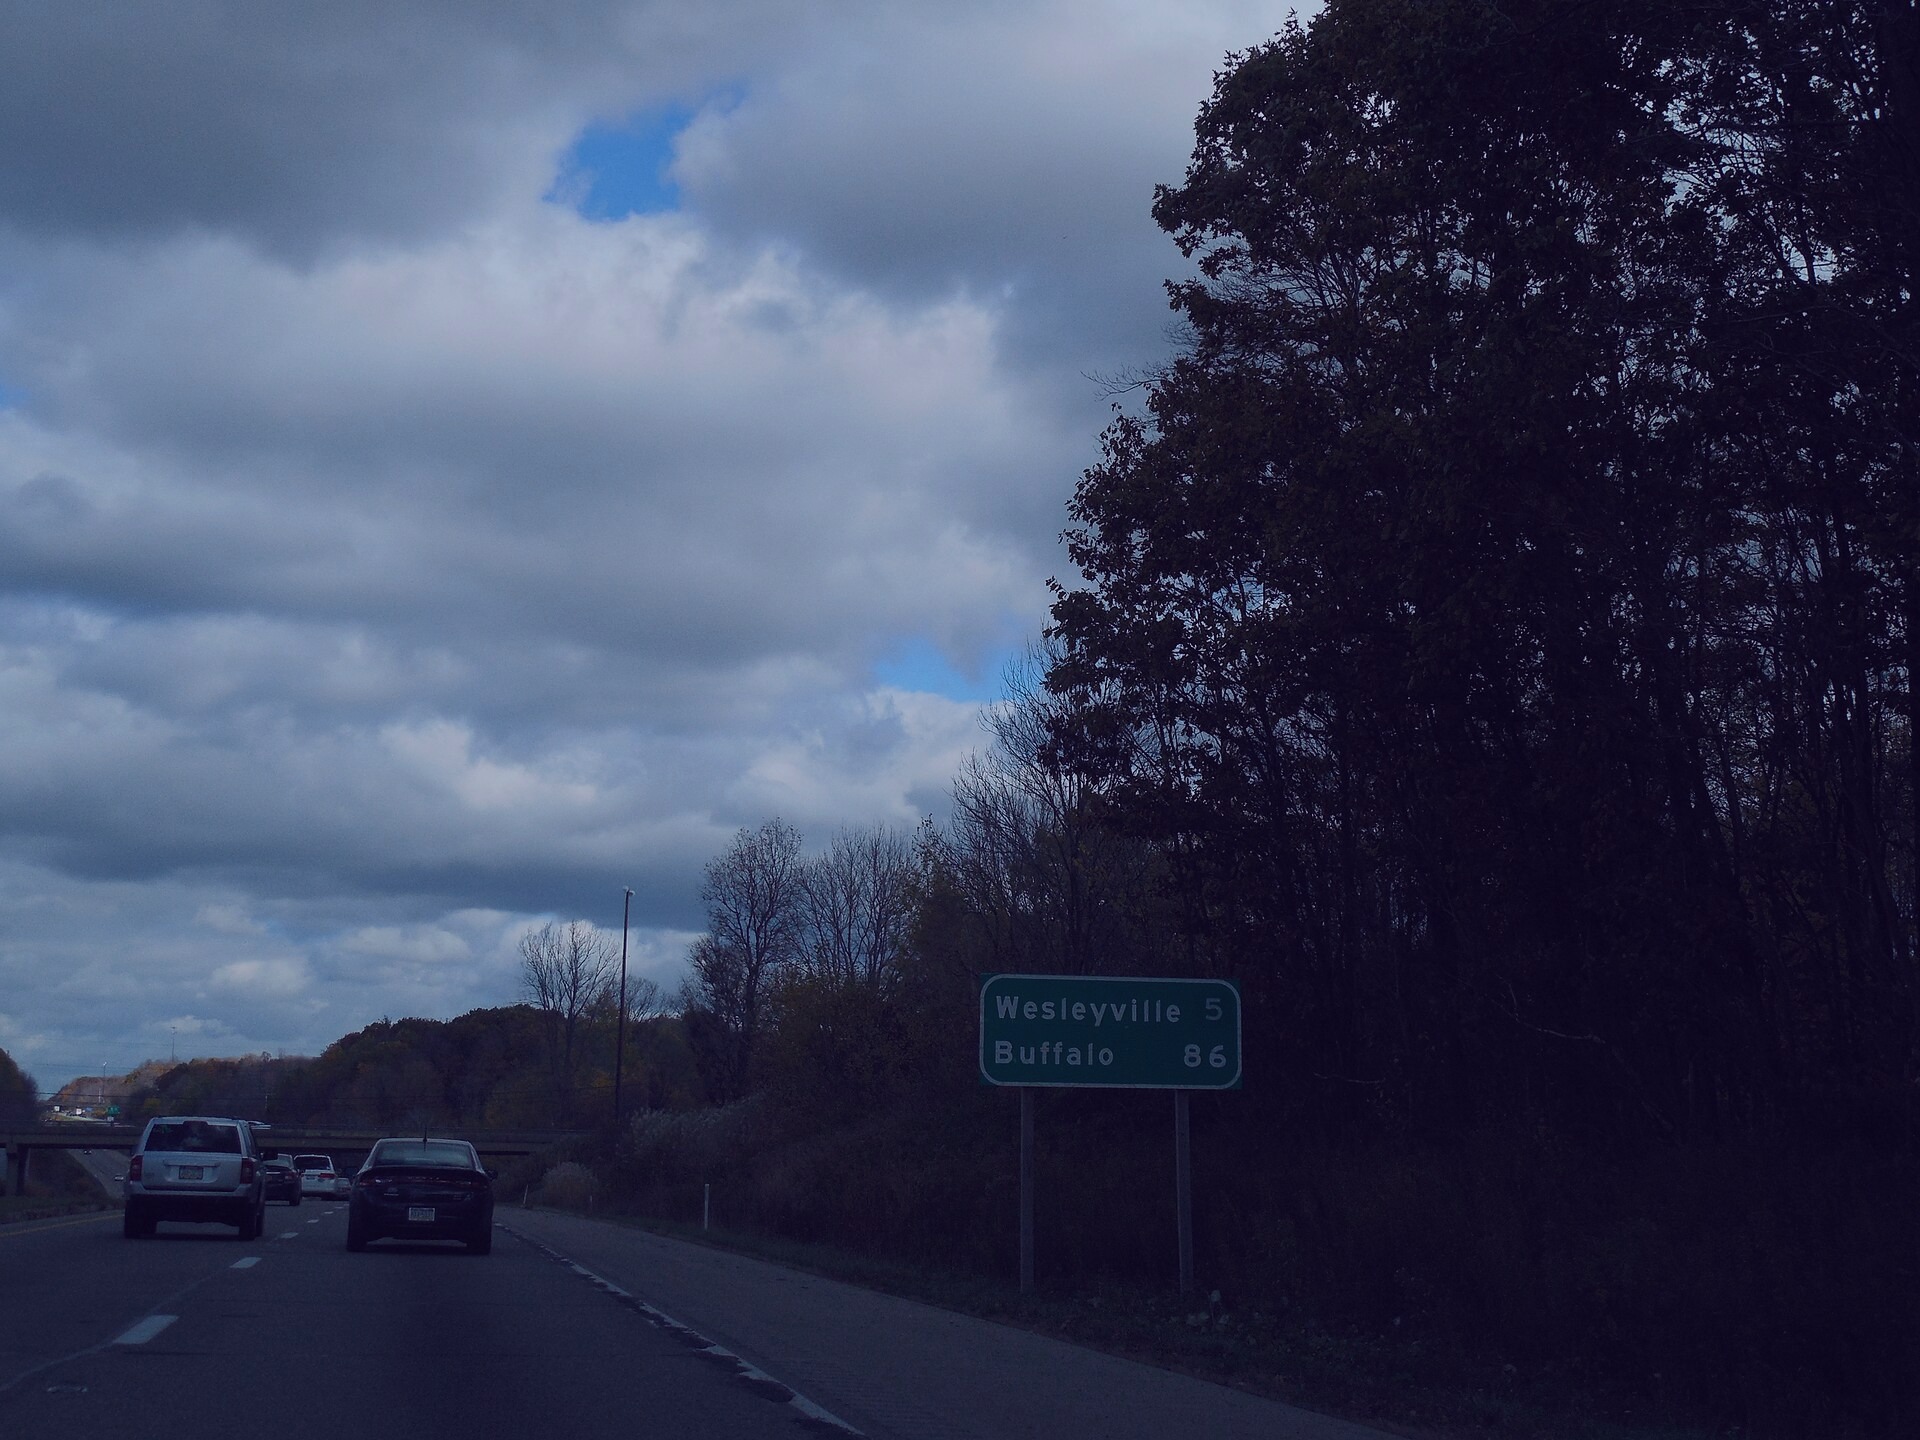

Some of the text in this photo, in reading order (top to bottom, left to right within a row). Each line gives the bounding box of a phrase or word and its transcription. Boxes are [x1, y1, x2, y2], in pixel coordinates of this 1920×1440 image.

[996, 996, 1222, 1027] Wesleyville 5
[995, 1041, 1227, 1068] Buffalo 86
